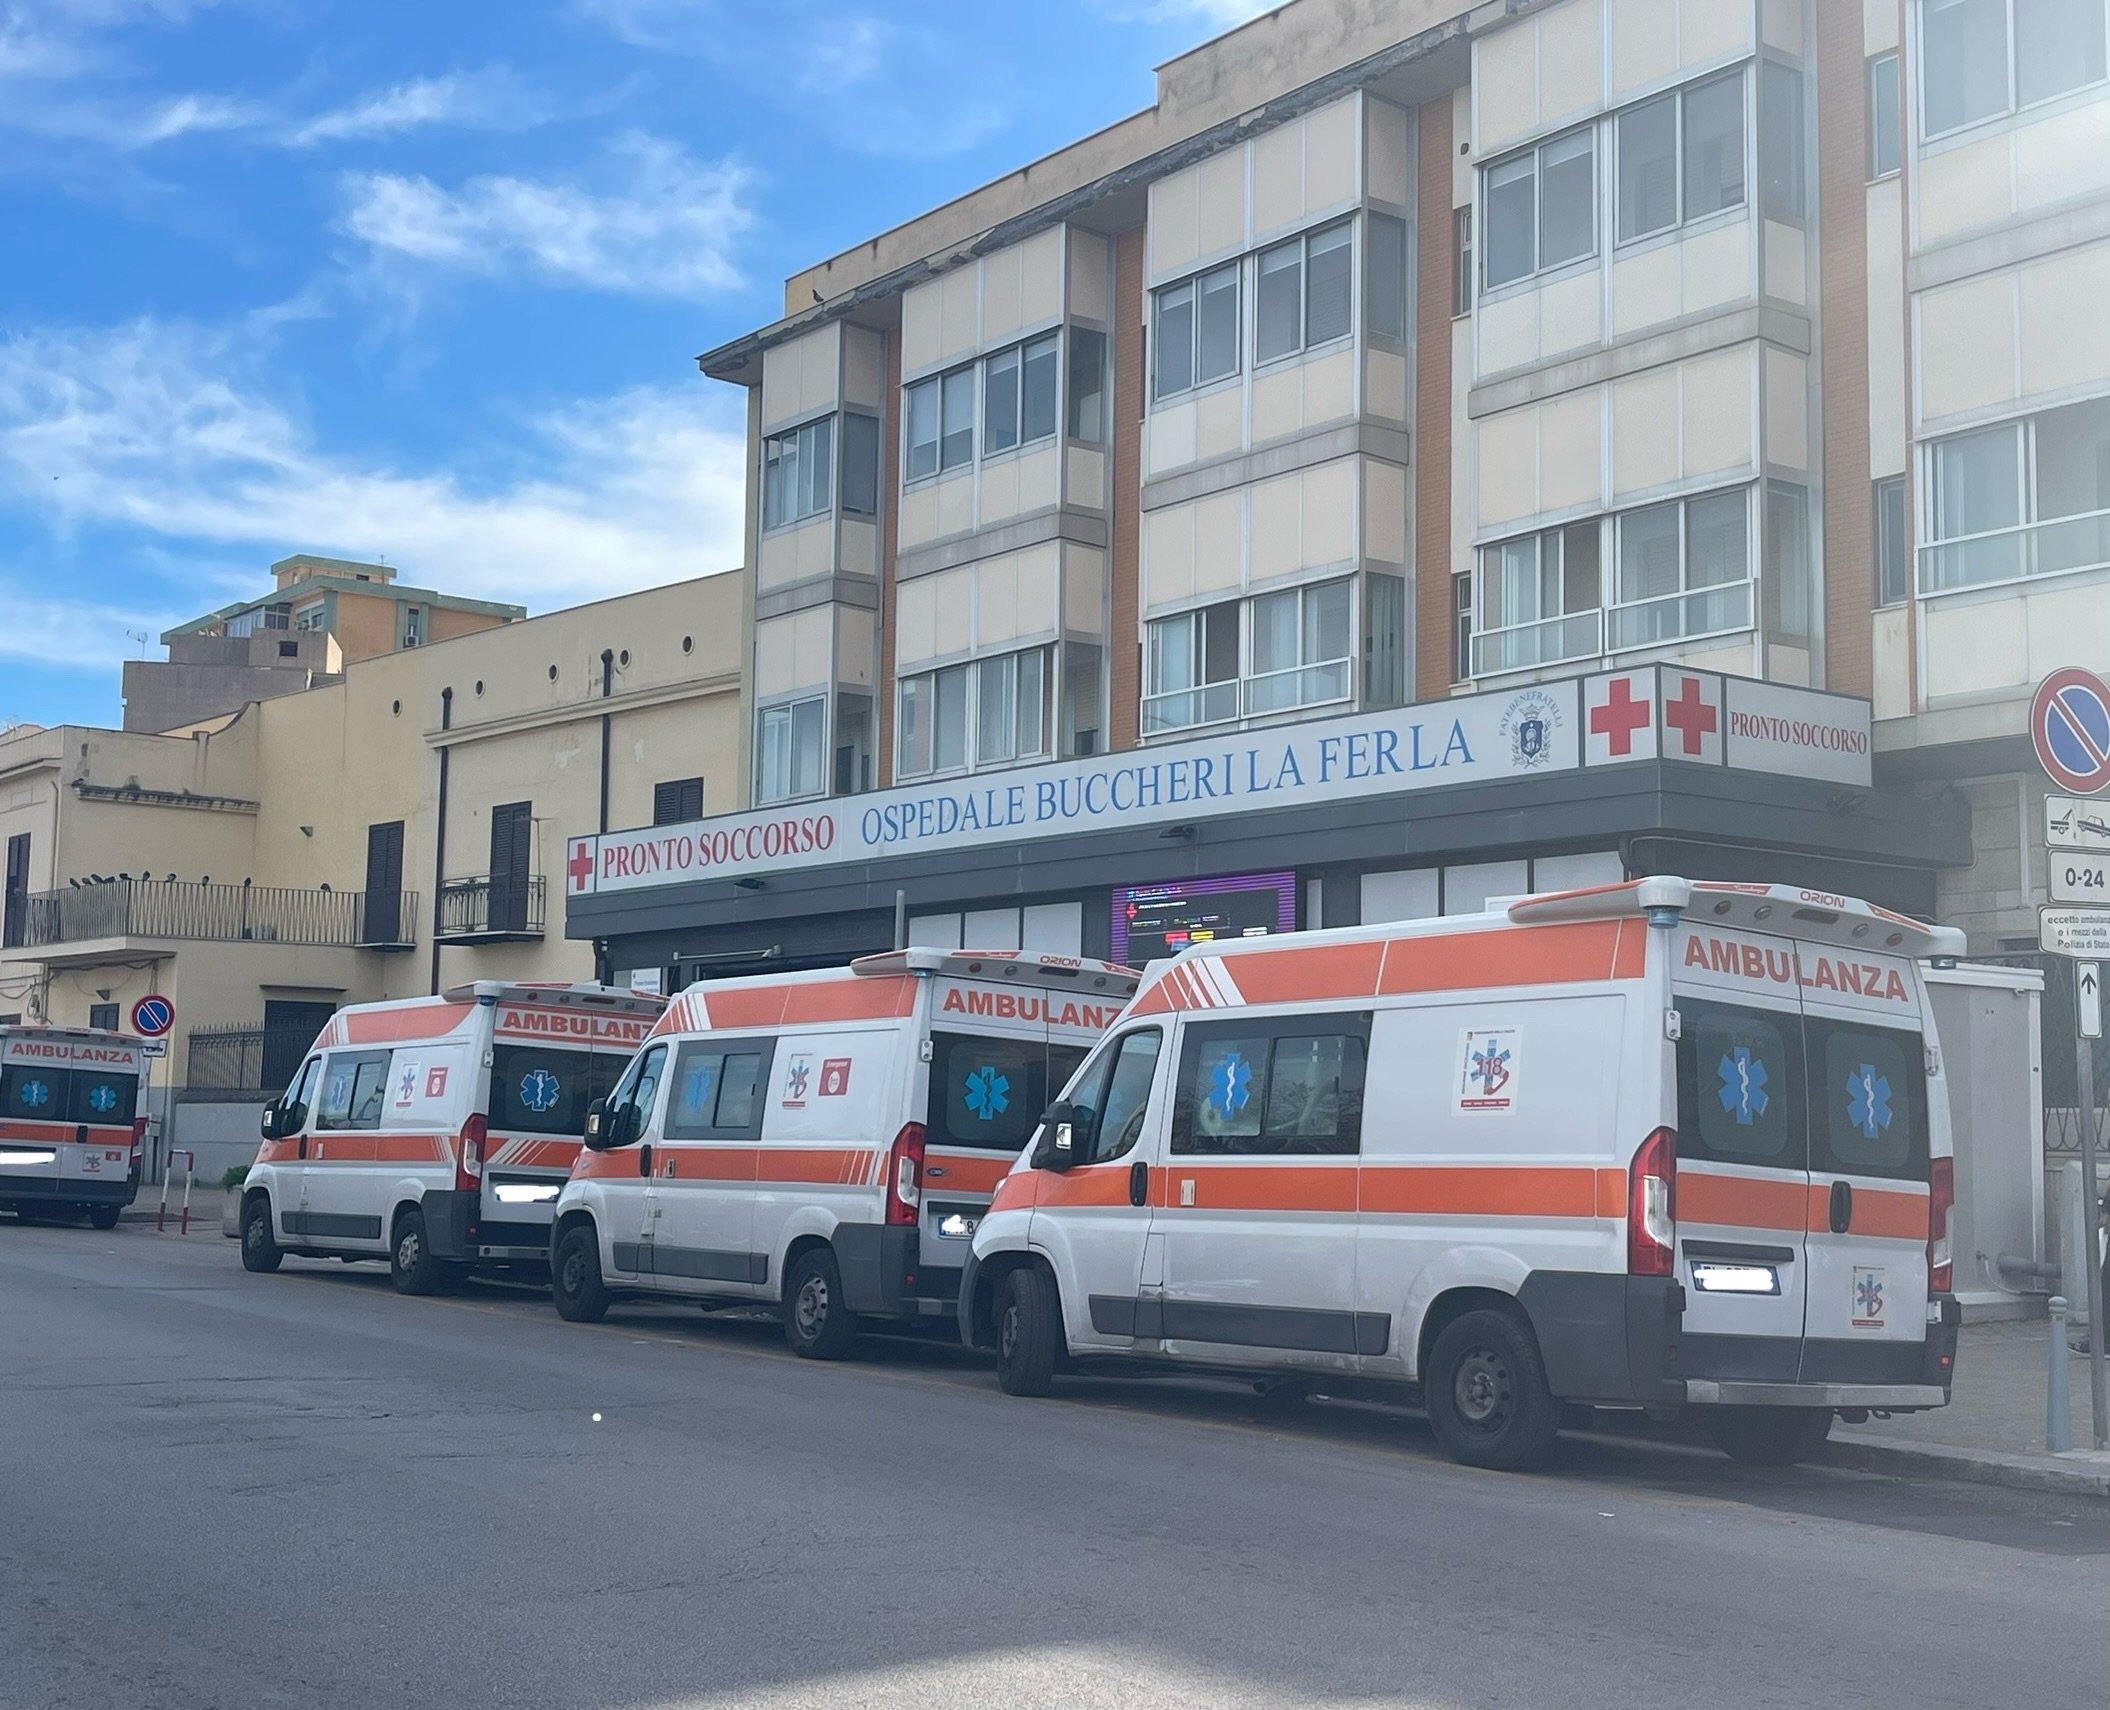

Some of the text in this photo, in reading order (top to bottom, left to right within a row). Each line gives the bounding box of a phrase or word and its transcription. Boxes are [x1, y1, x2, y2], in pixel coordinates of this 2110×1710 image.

[1730, 711, 1868, 755] PRONTO SOCCORSO
[861, 718, 1476, 845] OSPEDALE BUCCHERI LA FERLA
[602, 814, 835, 879] PRONTO SOCCORSO
[2065, 867, 2105, 888] 0-24
[1800, 890, 1846, 909] ORION
[2047, 915, 2079, 924] eccetto
[1039, 955, 1082, 968] ORION
[1684, 934, 1908, 1002] AMBULANZA
[943, 988, 1122, 1030] AMBULANZ
[11, 1042, 134, 1065] AMBULANZA
